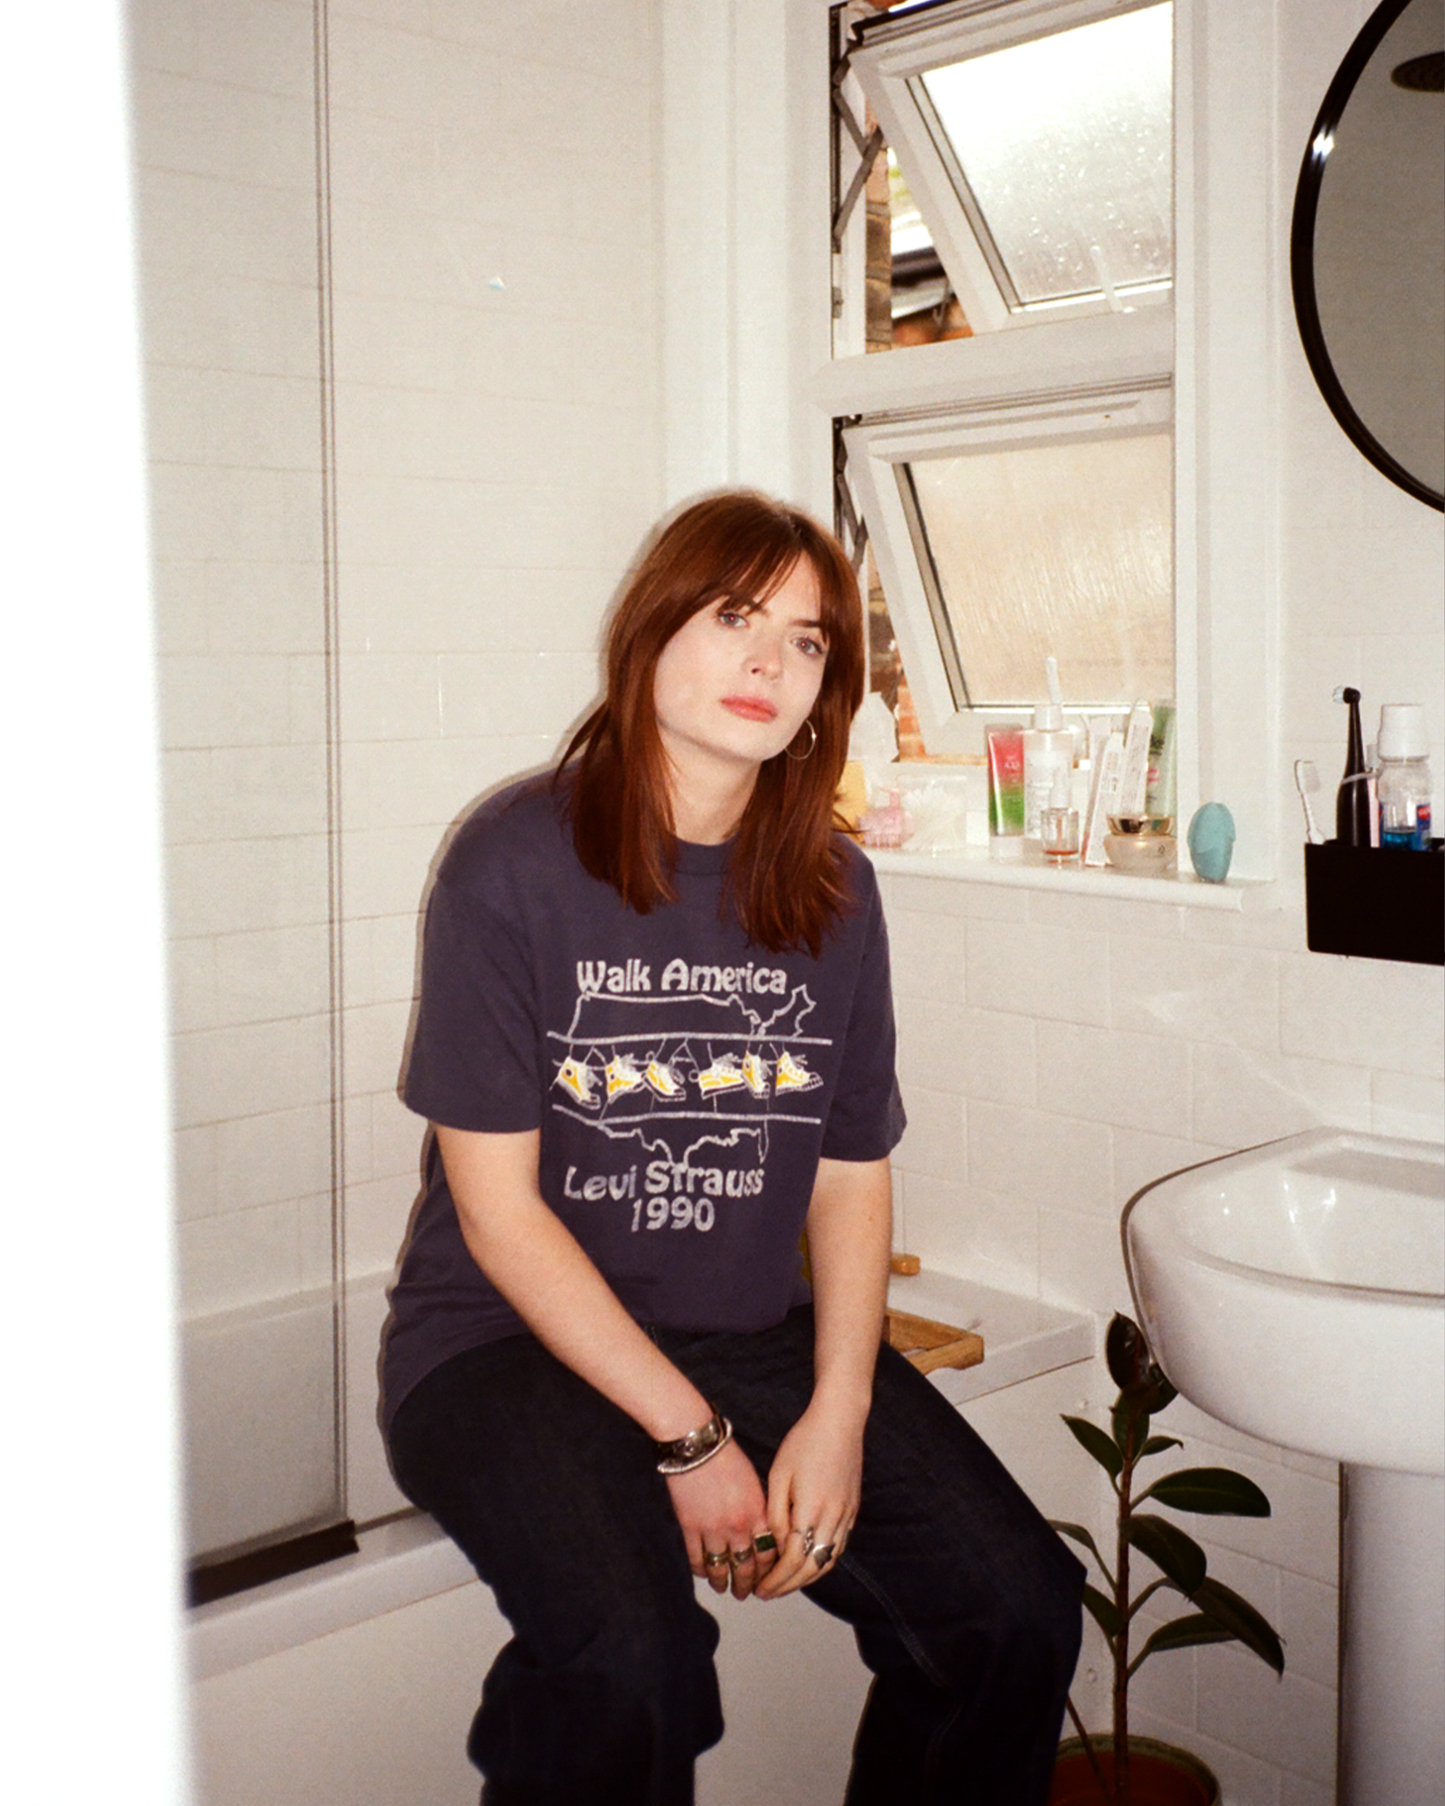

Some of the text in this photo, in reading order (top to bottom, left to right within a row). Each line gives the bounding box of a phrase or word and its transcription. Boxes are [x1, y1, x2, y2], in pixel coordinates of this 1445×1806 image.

[576, 958, 787, 994] Walk America
[563, 1160, 764, 1201] Levi Strauss
[631, 1196, 715, 1232] 1990
